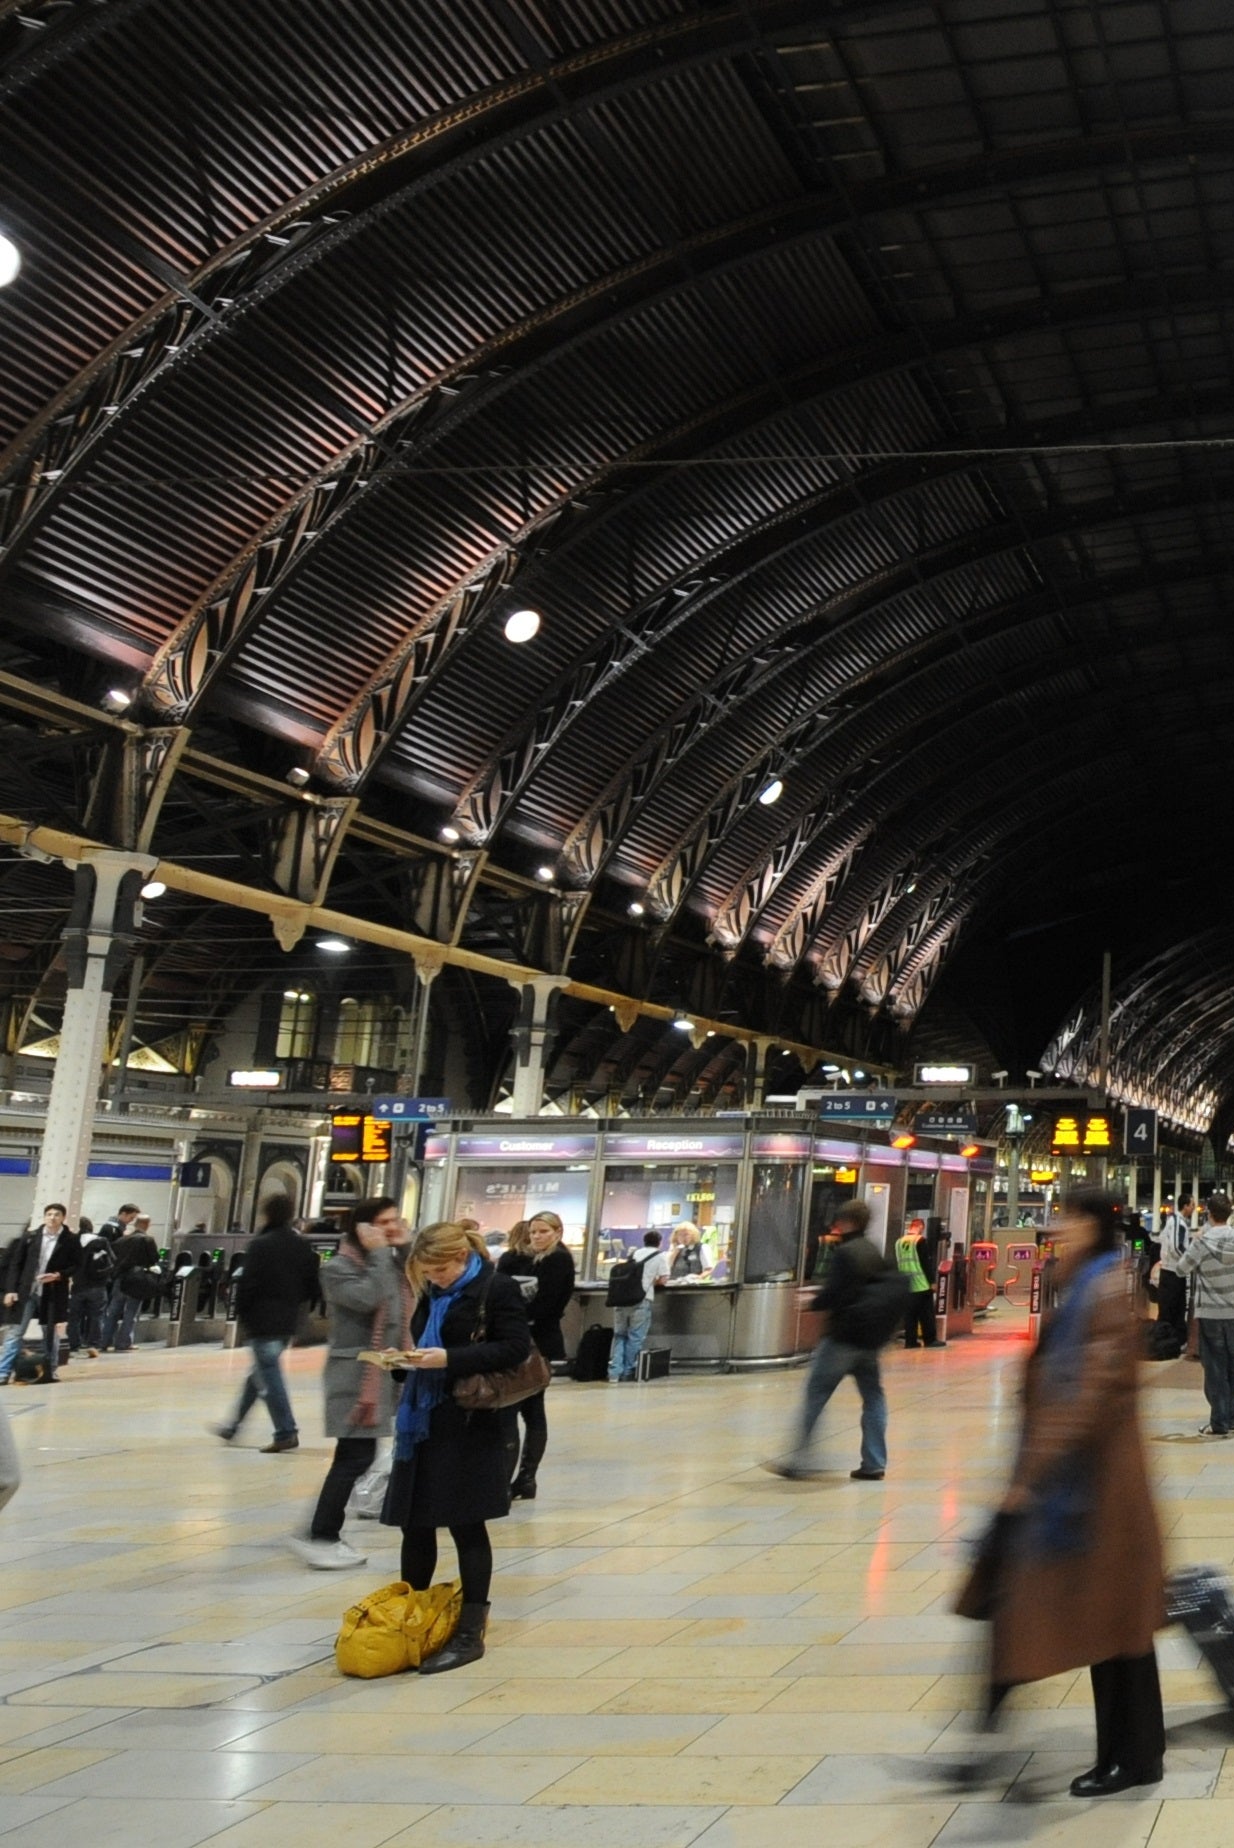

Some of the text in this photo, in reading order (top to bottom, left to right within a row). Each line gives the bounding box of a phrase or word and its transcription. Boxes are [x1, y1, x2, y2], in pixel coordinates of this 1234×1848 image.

[418, 1104, 445, 1112] 2 to 5
[826, 1101, 850, 1110] 2 to 5
[1133, 1123, 1148, 1140] 4
[500, 1140, 555, 1151] Customer
[647, 1140, 704, 1151] Reception
